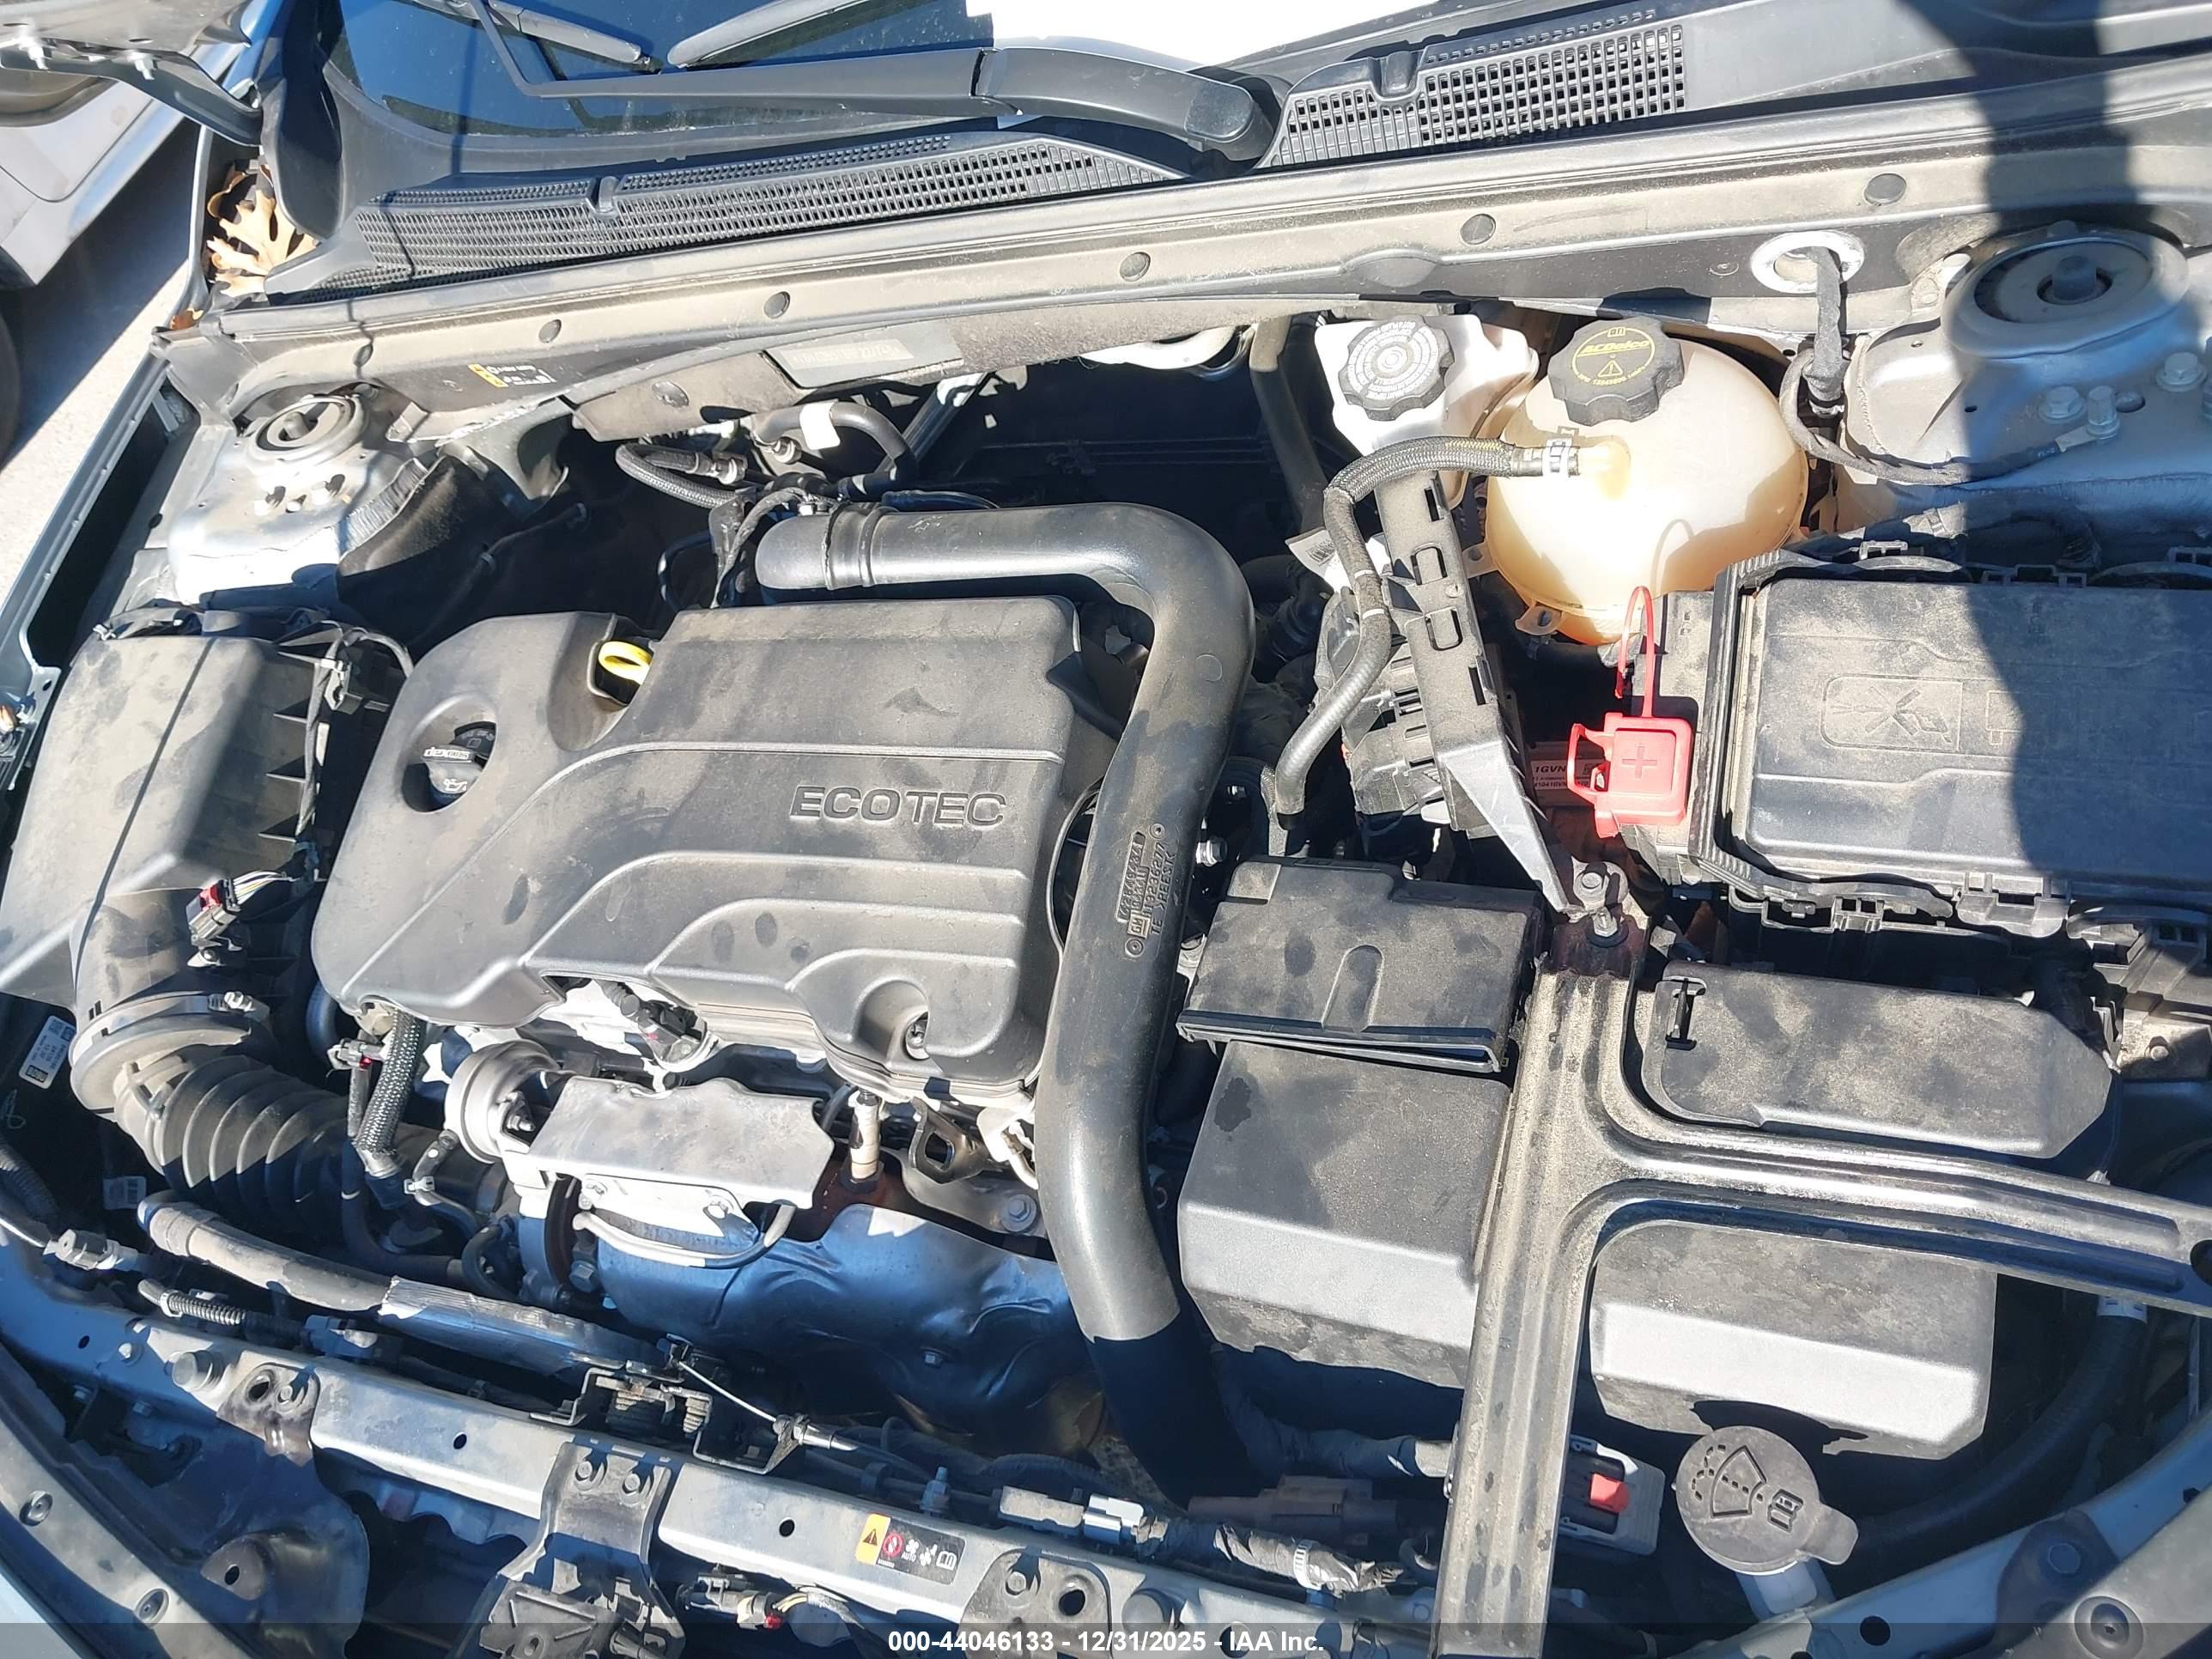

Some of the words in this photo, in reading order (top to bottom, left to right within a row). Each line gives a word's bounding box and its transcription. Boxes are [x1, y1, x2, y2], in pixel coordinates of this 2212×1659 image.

[1579, 340, 1650, 353] ACDelco
[789, 785, 1007, 827] ECOTEC
[902, 1551, 916, 1562] AUTO
